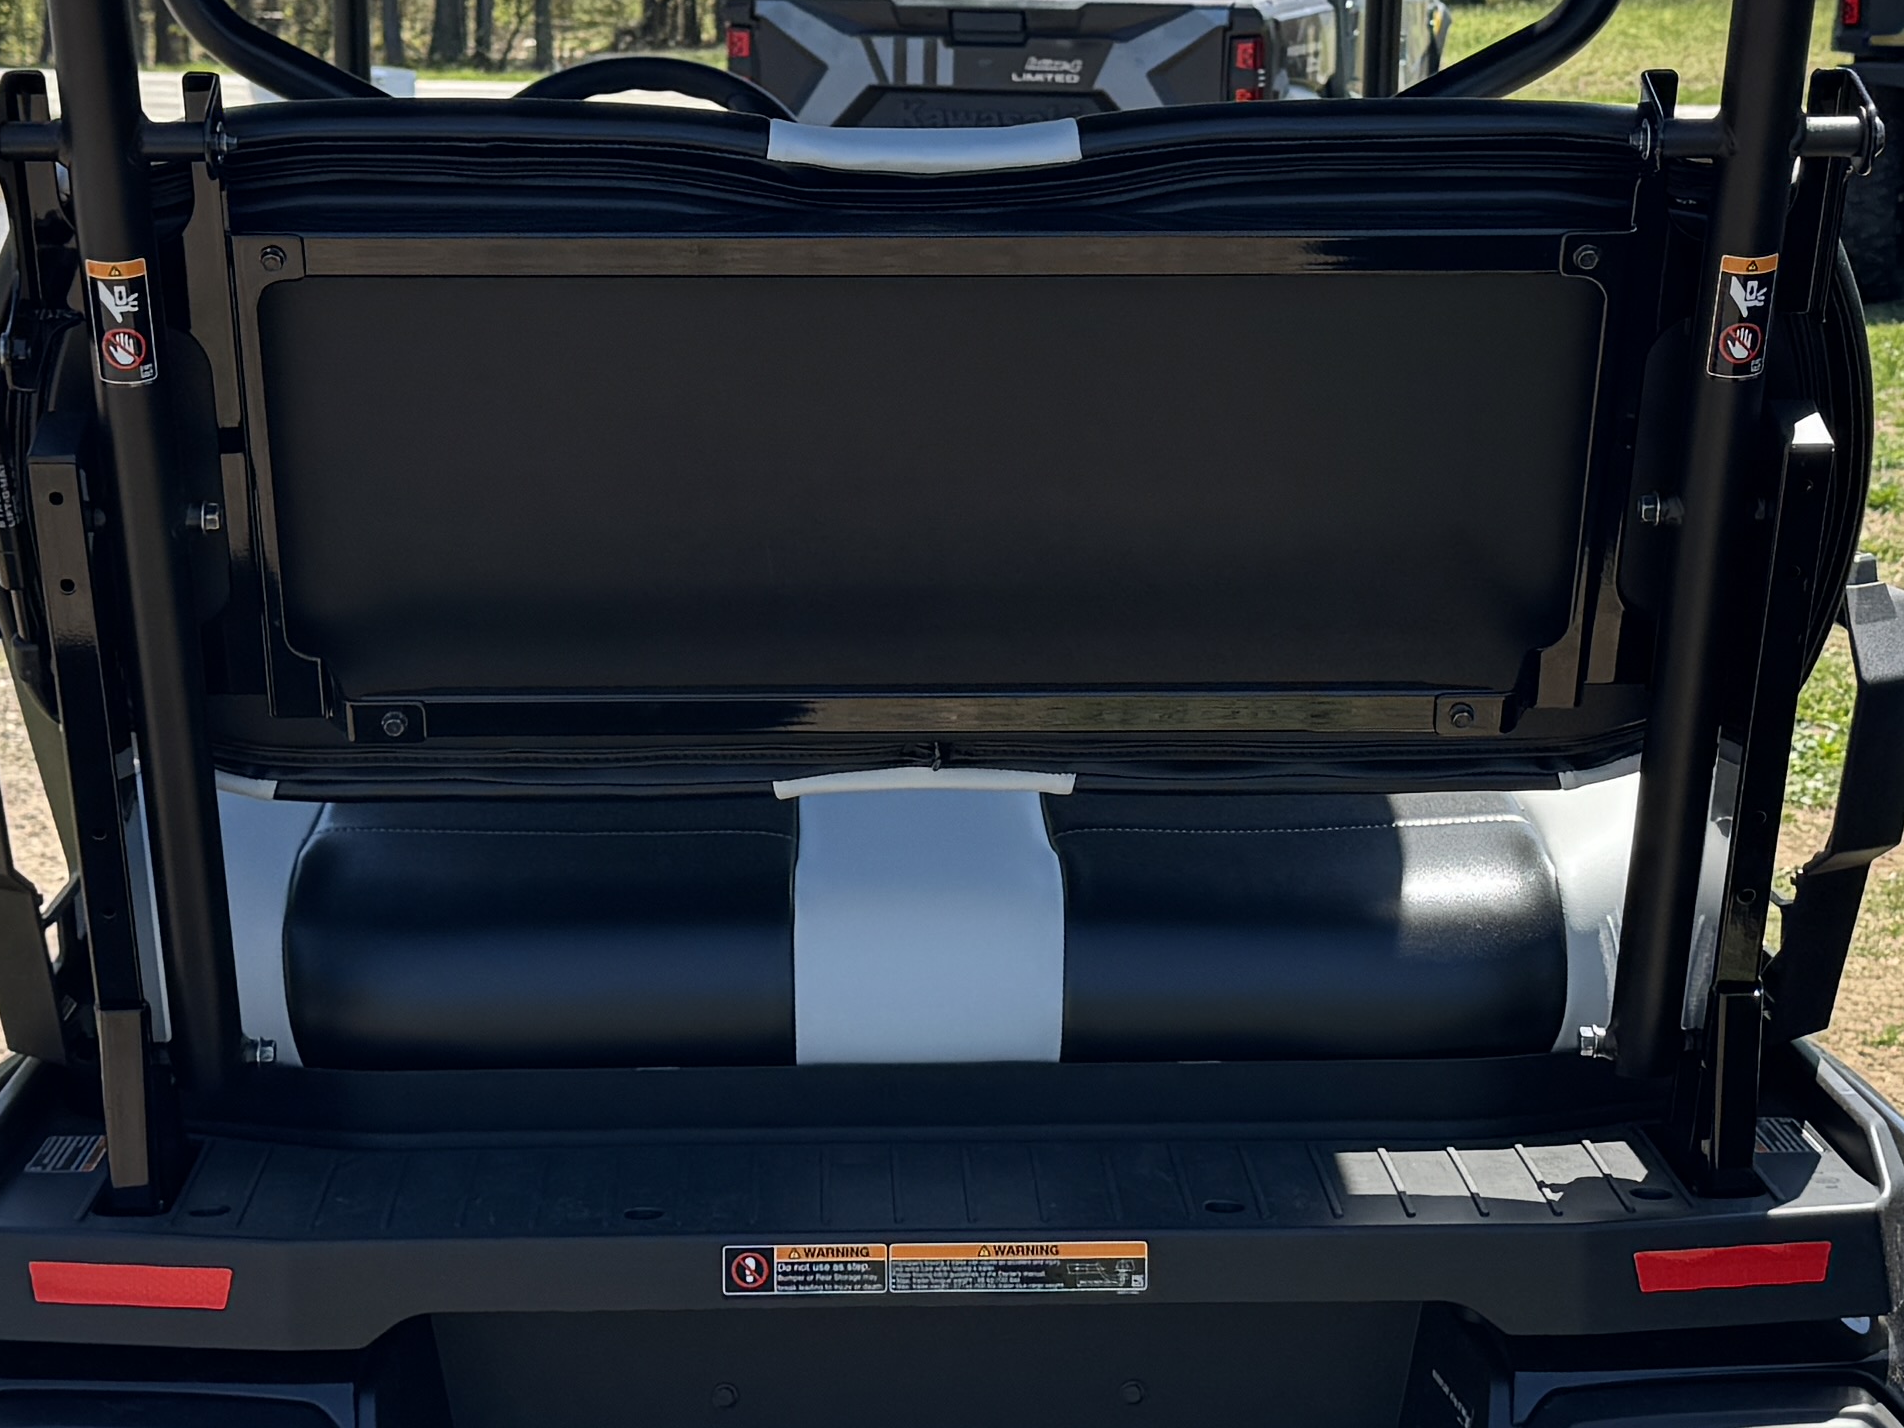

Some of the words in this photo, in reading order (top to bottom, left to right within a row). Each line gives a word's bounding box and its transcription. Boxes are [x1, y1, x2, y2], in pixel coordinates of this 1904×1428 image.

[1011, 72, 1080, 84] LIMITED
[803, 1246, 870, 1258] WARNING
[992, 1244, 1060, 1256] WARNING
[777, 1262, 792, 1272] Do
[793, 1262, 810, 1272] not
[812, 1262, 831, 1272] use
[832, 1263, 845, 1272] as
